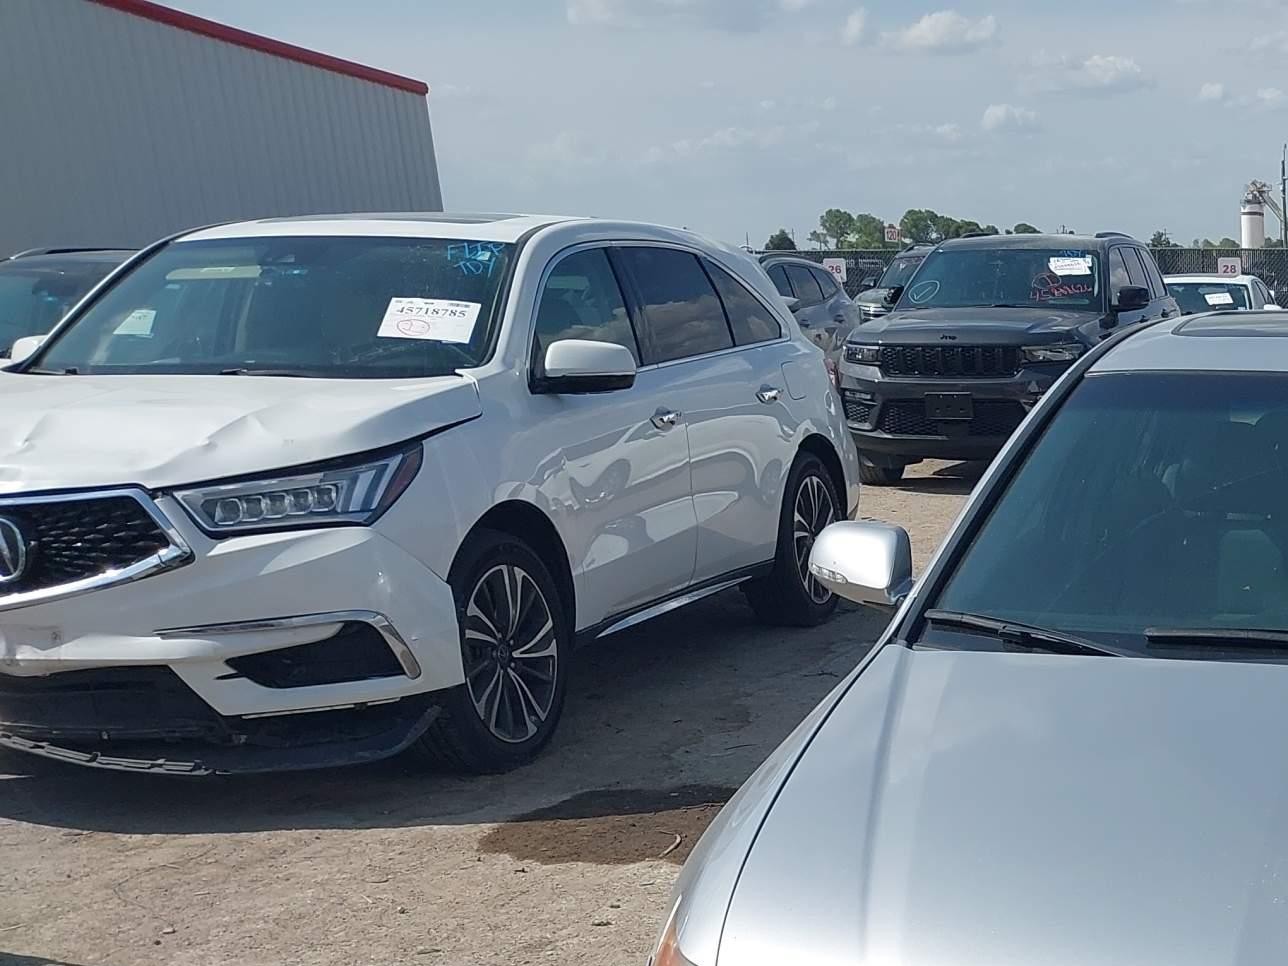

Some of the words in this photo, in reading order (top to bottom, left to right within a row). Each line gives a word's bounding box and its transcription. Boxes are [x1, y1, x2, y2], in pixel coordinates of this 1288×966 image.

[828, 265, 842, 274] 26
[1222, 264, 1237, 274] 28
[396, 306, 468, 318] 45718785
